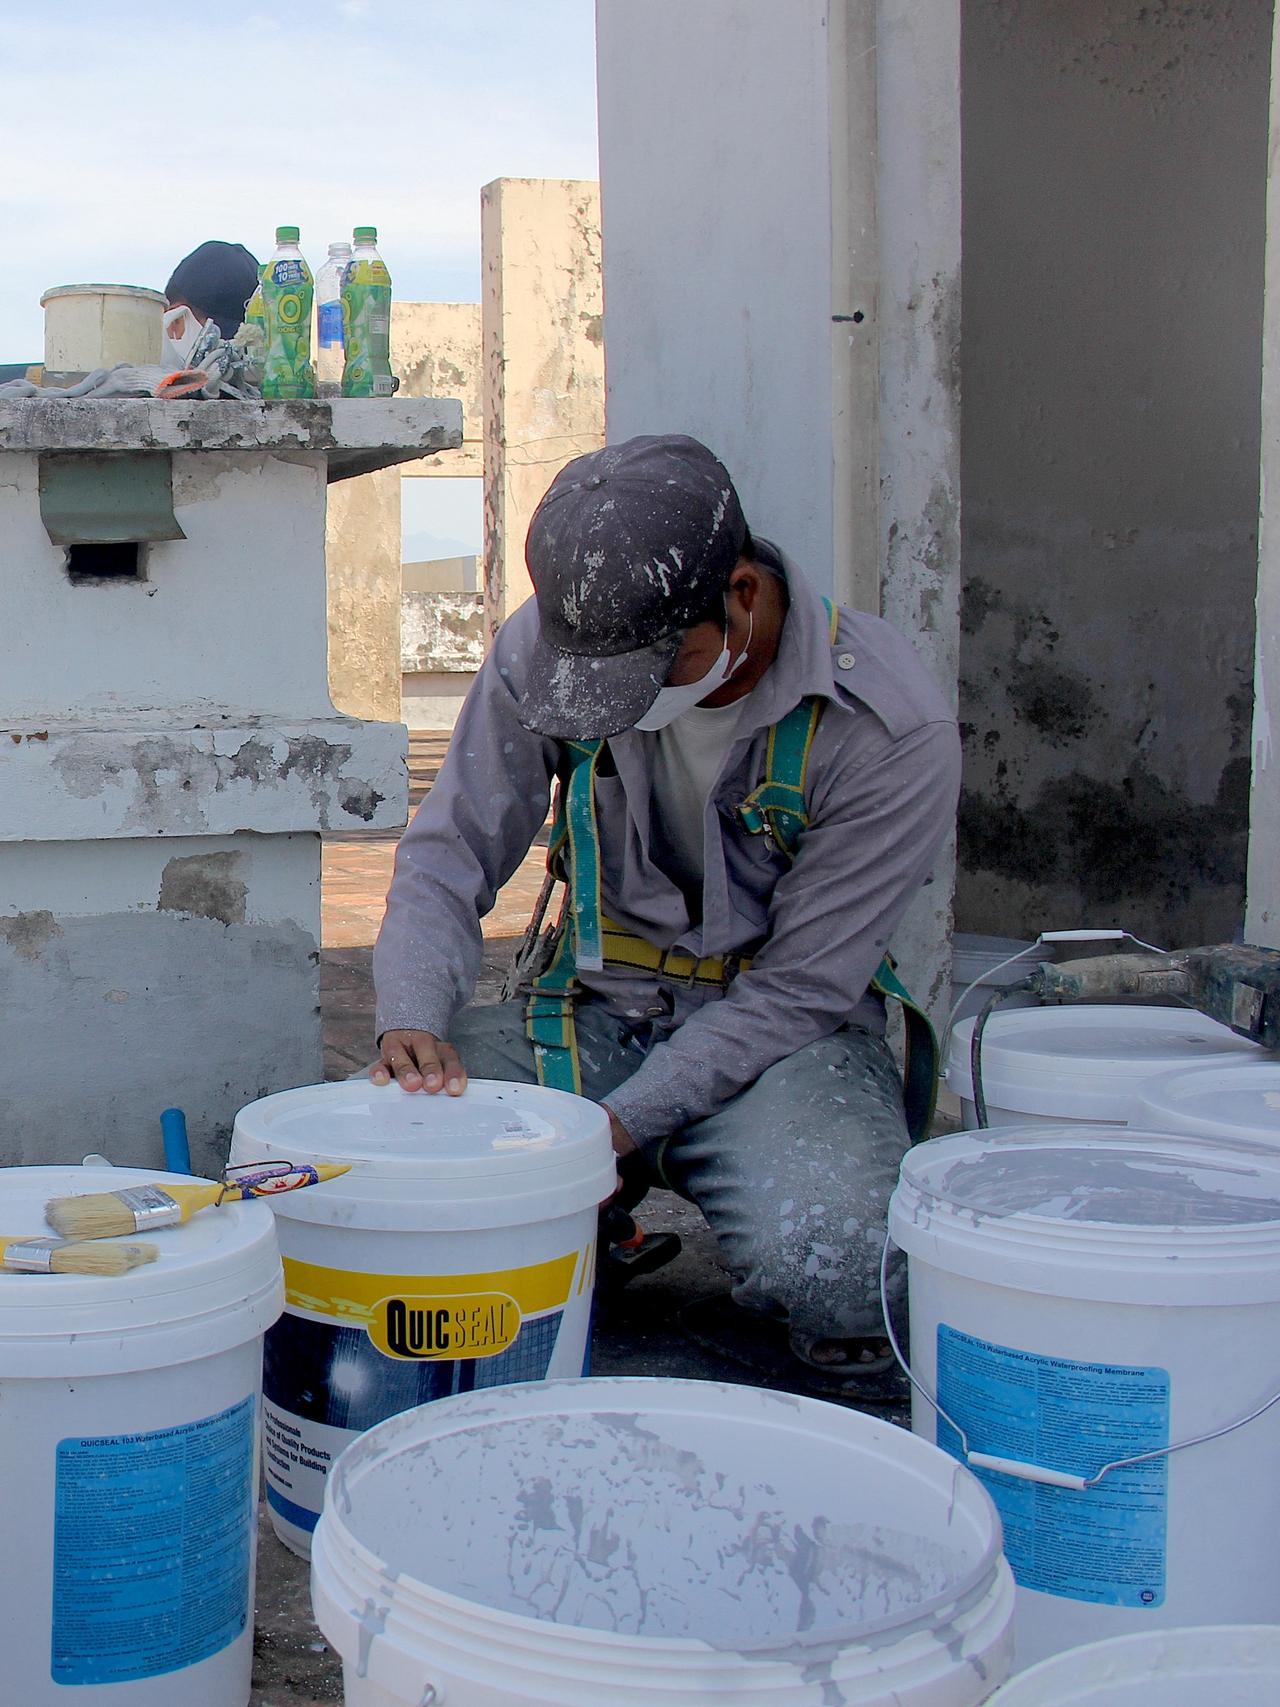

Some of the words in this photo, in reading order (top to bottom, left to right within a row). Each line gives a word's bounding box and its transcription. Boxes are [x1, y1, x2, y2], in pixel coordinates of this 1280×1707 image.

[1024, 1354, 1049, 1367] Acrylic
[1050, 1360, 1103, 1375] Waterproofing
[1104, 1367, 1145, 1377] Membrane
[80, 1438, 120, 1448] QUICSEAL
[135, 1431, 174, 1443] Waterbased
[300, 1443, 331, 1461] Products
[299, 1456, 327, 1475] Building
